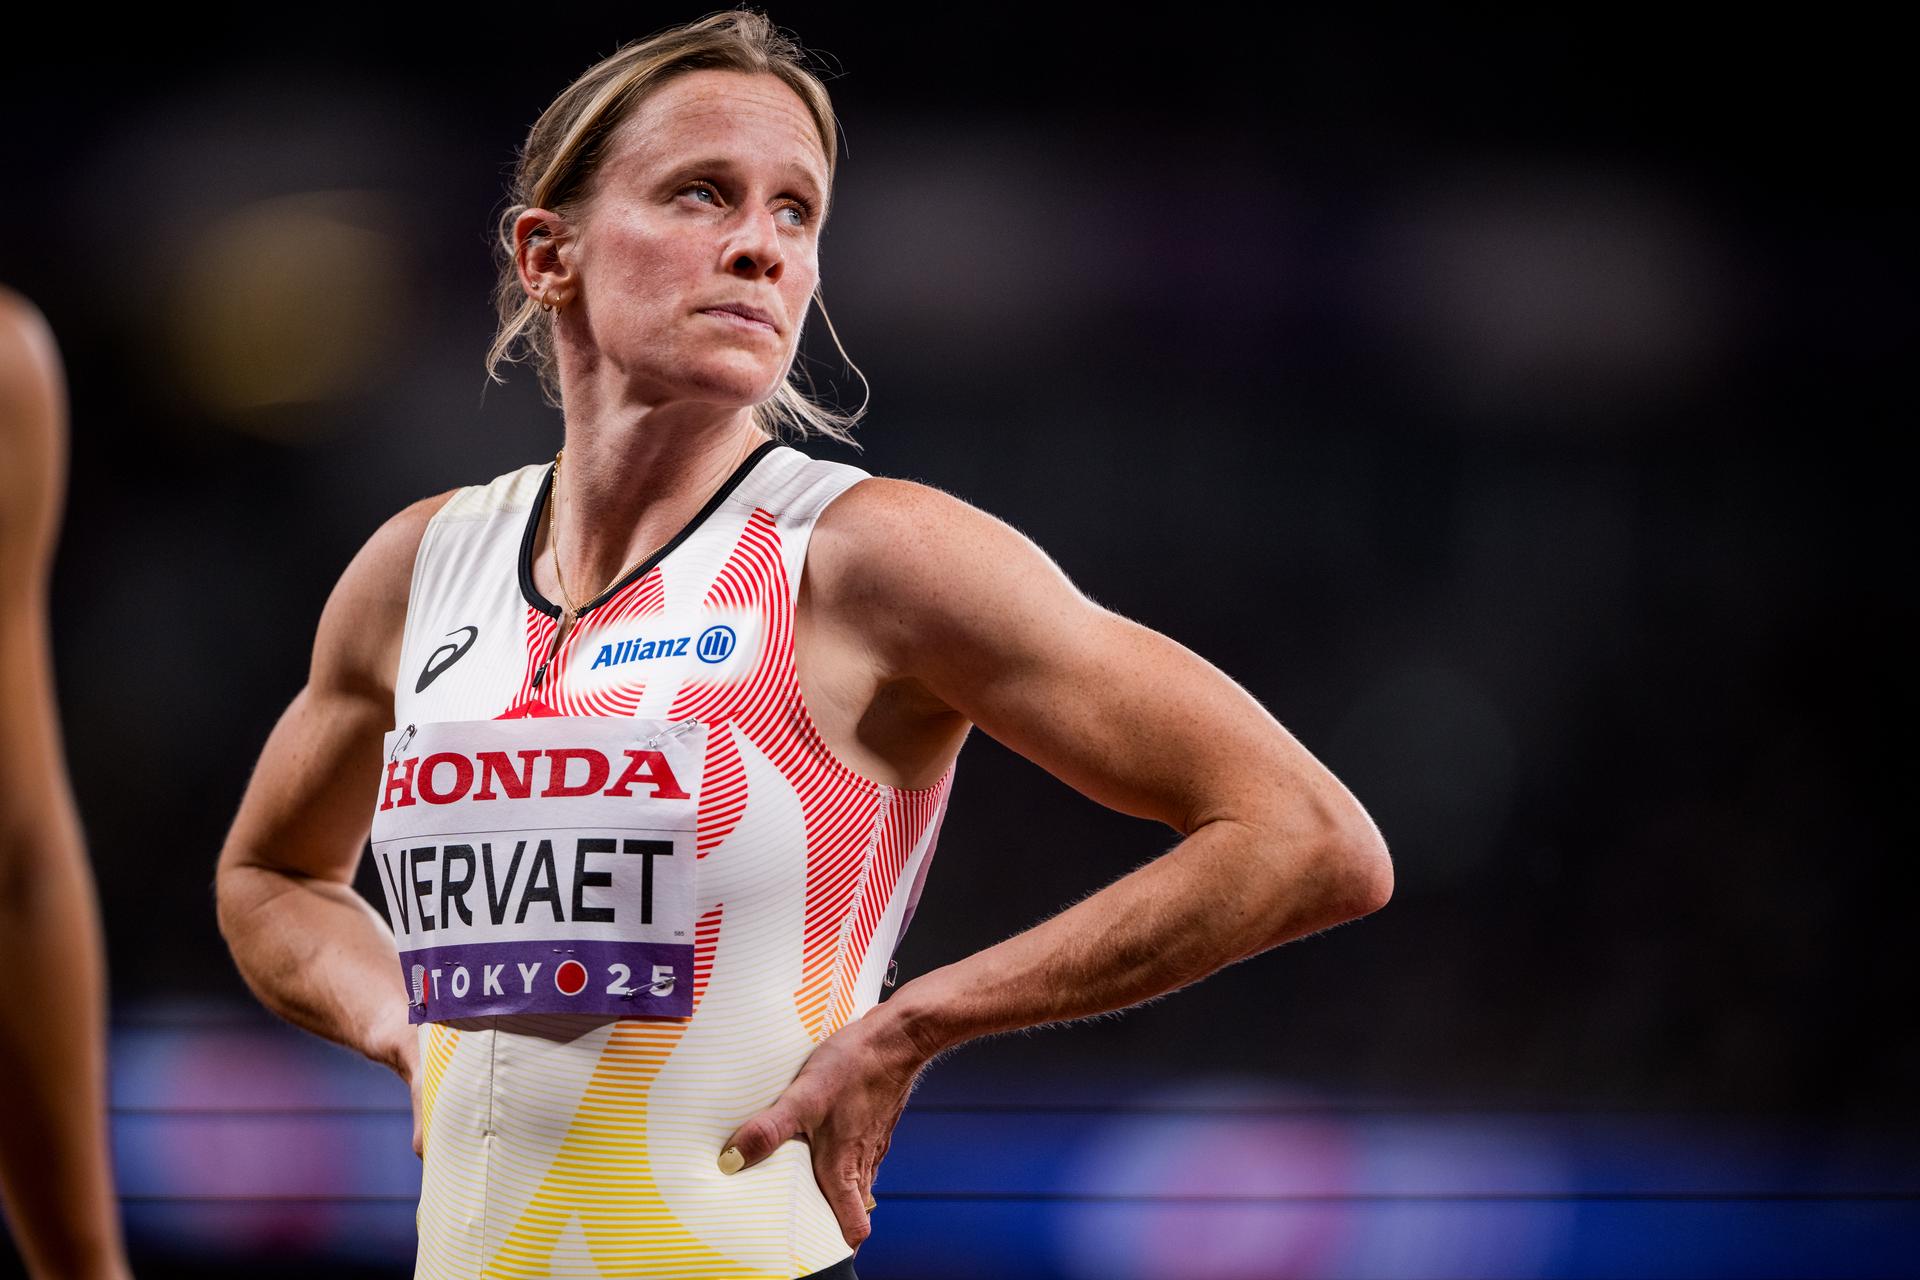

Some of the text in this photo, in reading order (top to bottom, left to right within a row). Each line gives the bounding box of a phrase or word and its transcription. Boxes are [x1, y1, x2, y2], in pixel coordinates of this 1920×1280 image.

[590, 637, 691, 670] Allianz
[380, 748, 690, 811] HONDA
[382, 838, 674, 934] VERVAET
[606, 963, 675, 997] 25
